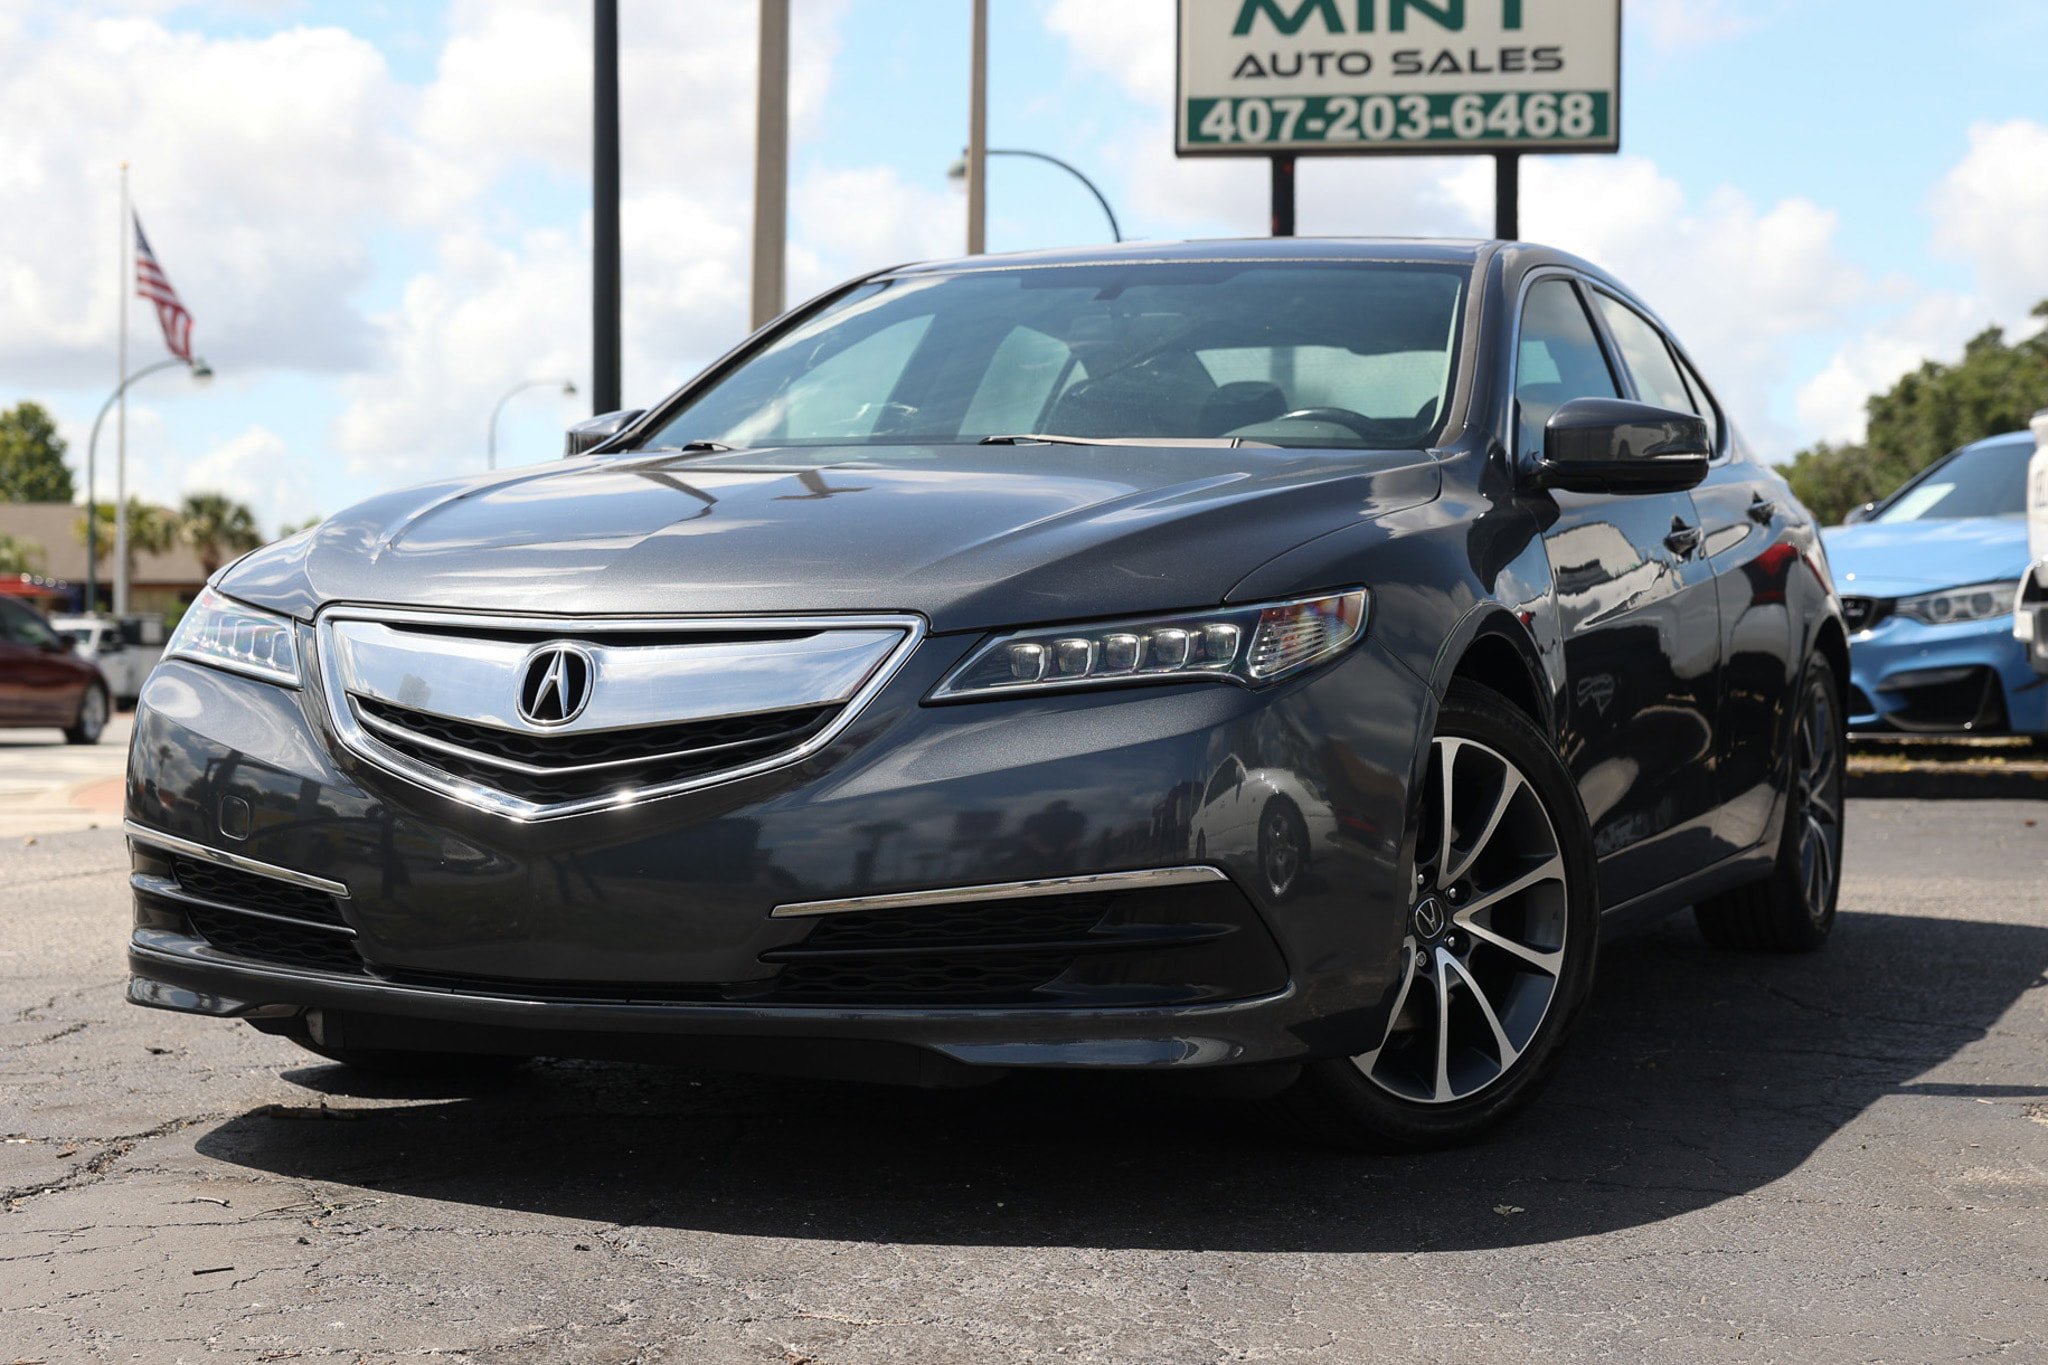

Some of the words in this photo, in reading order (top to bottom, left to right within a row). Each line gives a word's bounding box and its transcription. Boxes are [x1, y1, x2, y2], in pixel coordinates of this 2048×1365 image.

[1232, 51, 1373, 79] AUTO
[1391, 46, 1564, 76] SALES
[1200, 92, 1595, 142] 407-203-6468
